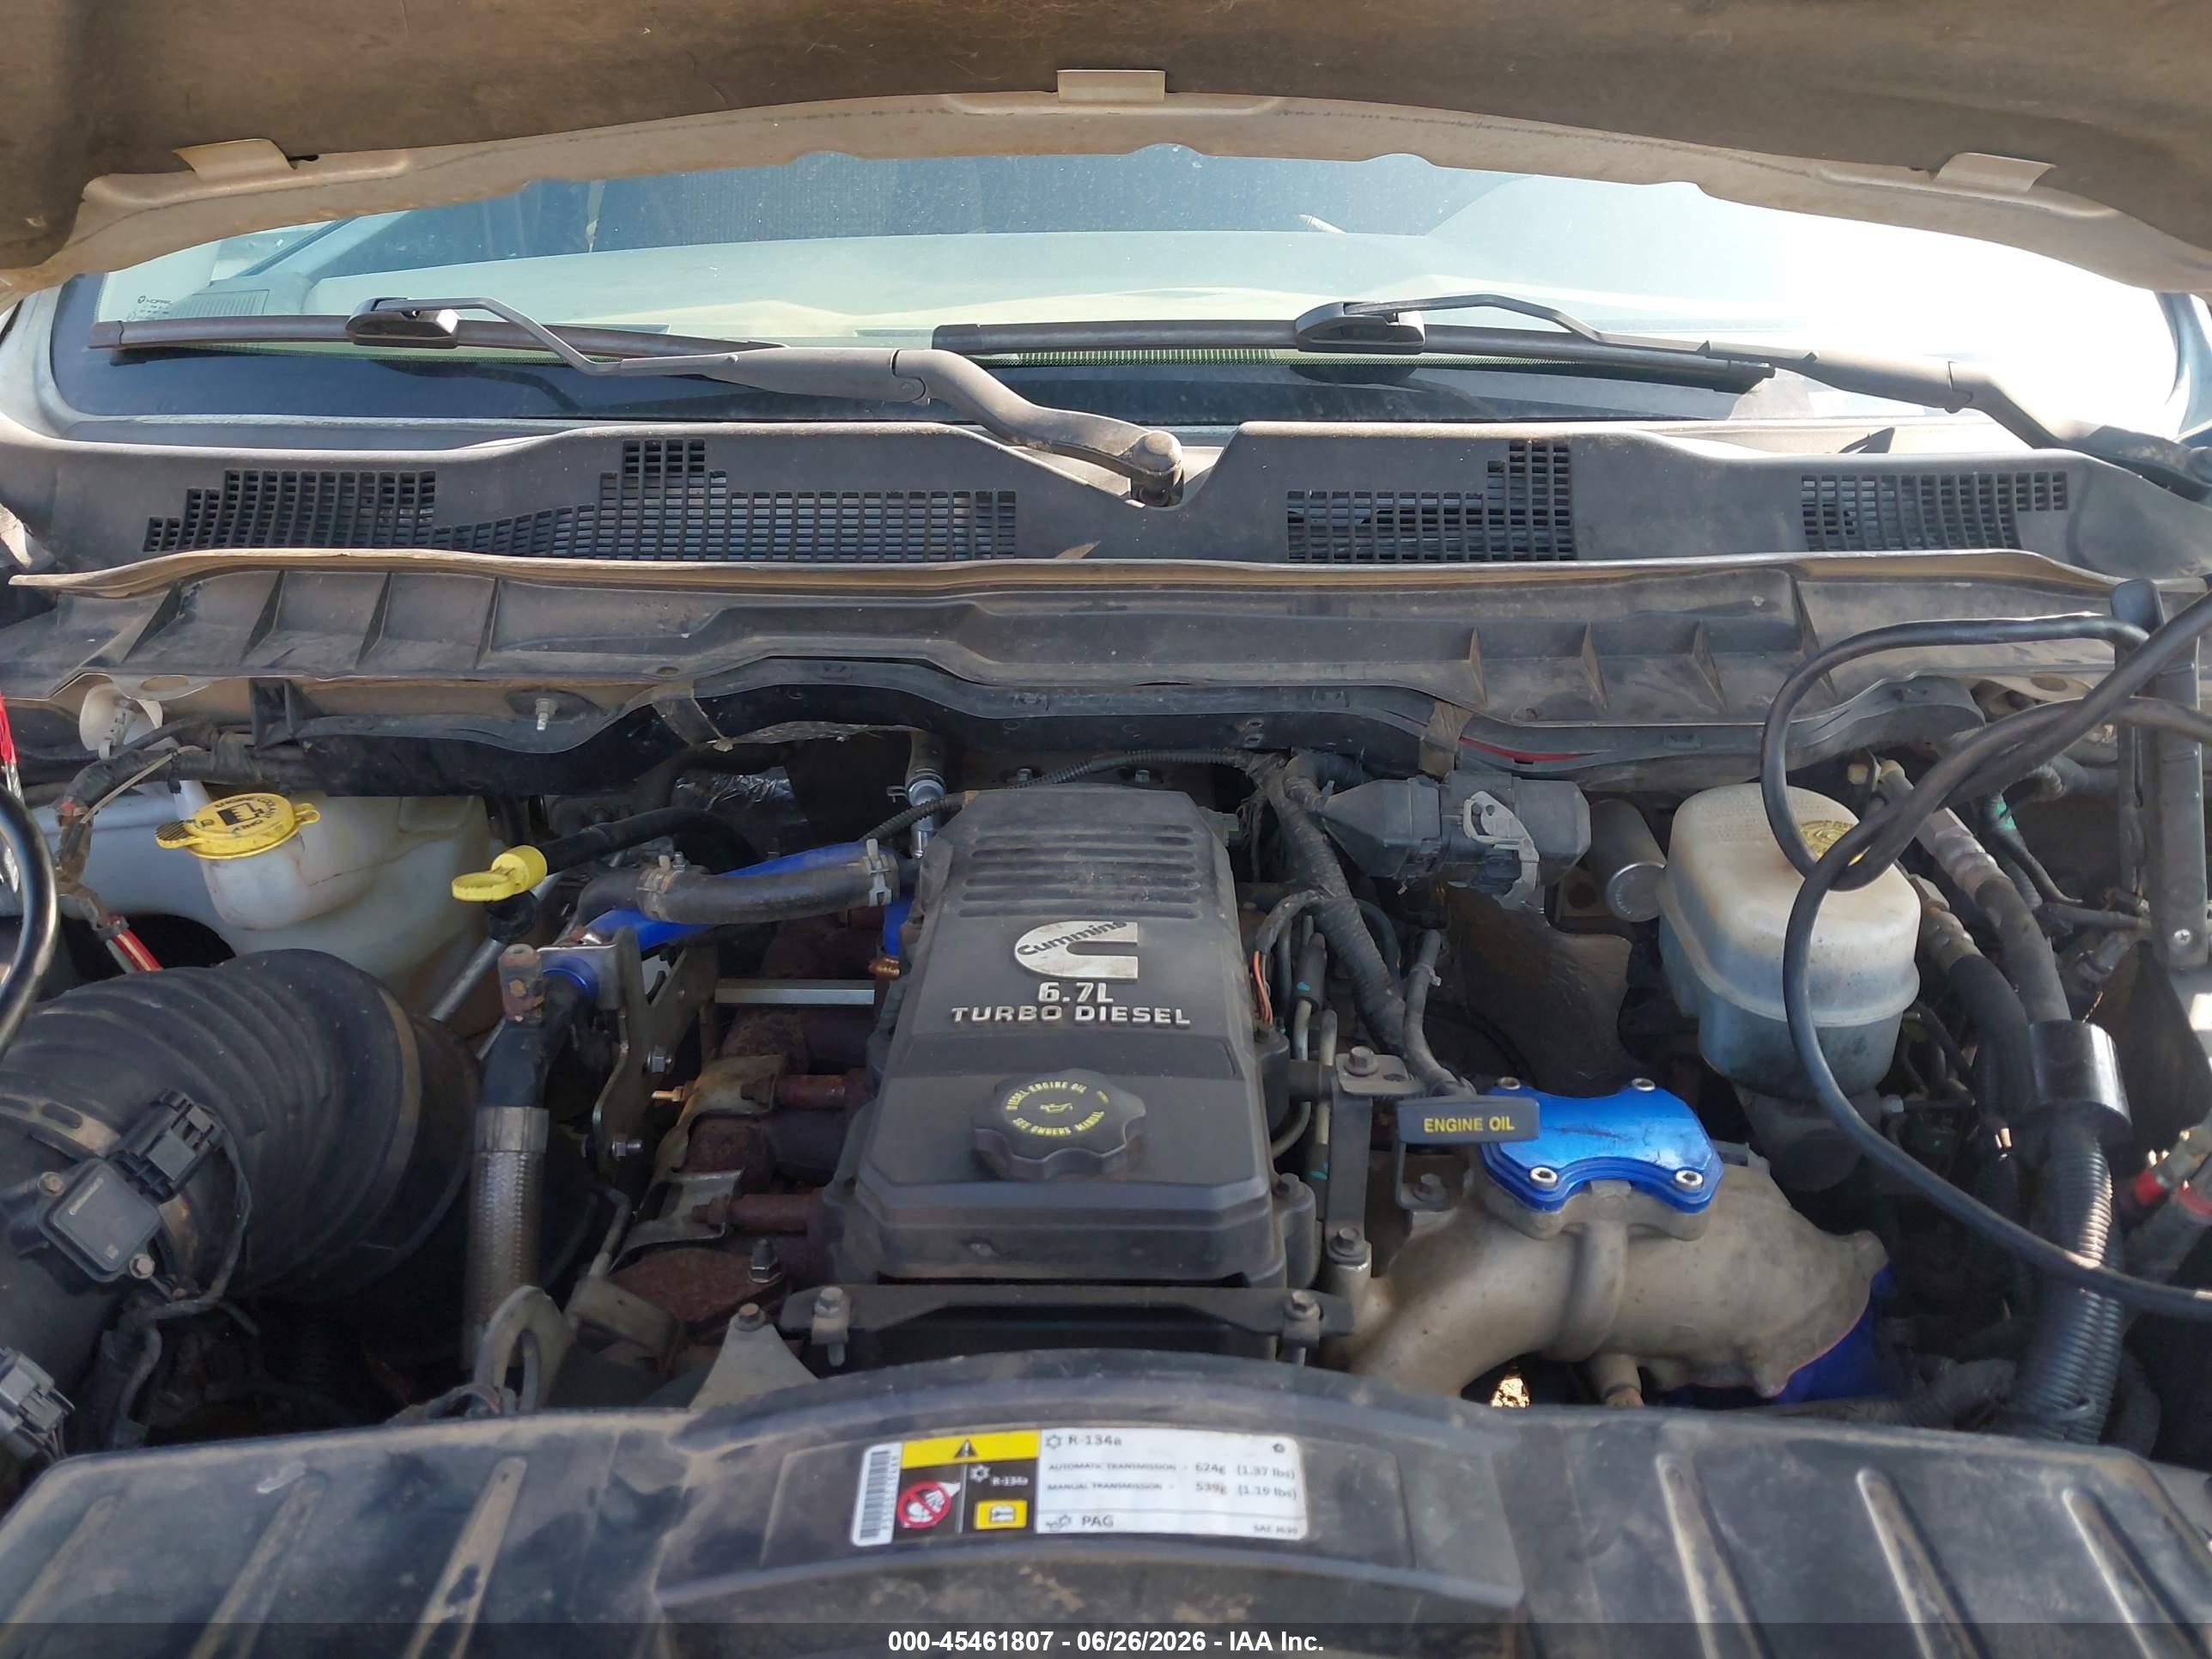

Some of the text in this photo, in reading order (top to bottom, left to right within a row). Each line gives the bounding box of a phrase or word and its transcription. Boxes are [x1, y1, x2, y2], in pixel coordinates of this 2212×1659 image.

[215, 796, 278, 833] ENGINE COOLANT ONLY
[1017, 920, 1127, 956] Cummins
[1037, 981, 1115, 1004] 6.7L
[951, 1006, 1191, 1025] TURBO DIESEL
[1006, 1081, 1087, 1110] DIESEL ENGINE OIL
[1012, 1117, 1031, 1129] SEE
[1074, 1110, 1105, 1132] MANUAL
[1423, 1115, 1516, 1133] ENGINE OIL
[1068, 1434, 1122, 1446] R-134a
[990, 1475, 1029, 1486] R-134a
[1048, 1462, 1102, 1471] AUTOMATIC
[1106, 1462, 1176, 1471] TRANSMISSION
[1195, 1462, 1226, 1475] 624g
[1273, 1467, 1296, 1480] lbs)
[1091, 1482, 1163, 1491] TRANSMISSION
[1195, 1481, 1227, 1495] 539g
[1274, 1486, 1297, 1500] lbs)
[1081, 1515, 1115, 1528] PAG
